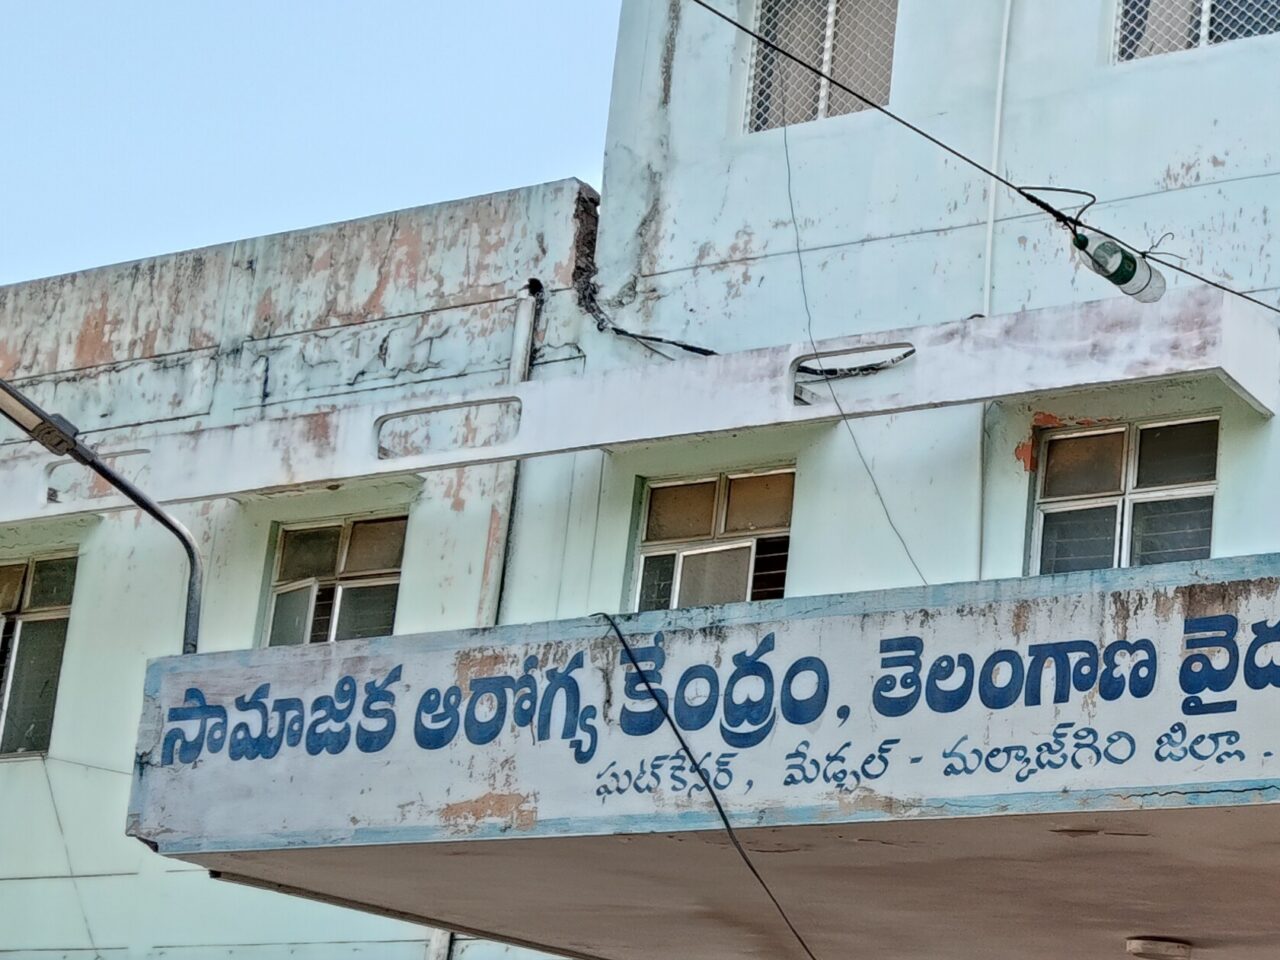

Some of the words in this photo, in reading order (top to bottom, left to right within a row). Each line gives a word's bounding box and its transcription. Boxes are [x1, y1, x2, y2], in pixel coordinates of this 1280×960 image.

[161, 664, 403, 767] సామాజిక
[413, 651, 598, 764] ఆరోగ్య
[619, 631, 850, 749] కేంద్రం,
[872, 635, 1157, 718] తెలంగాణ
